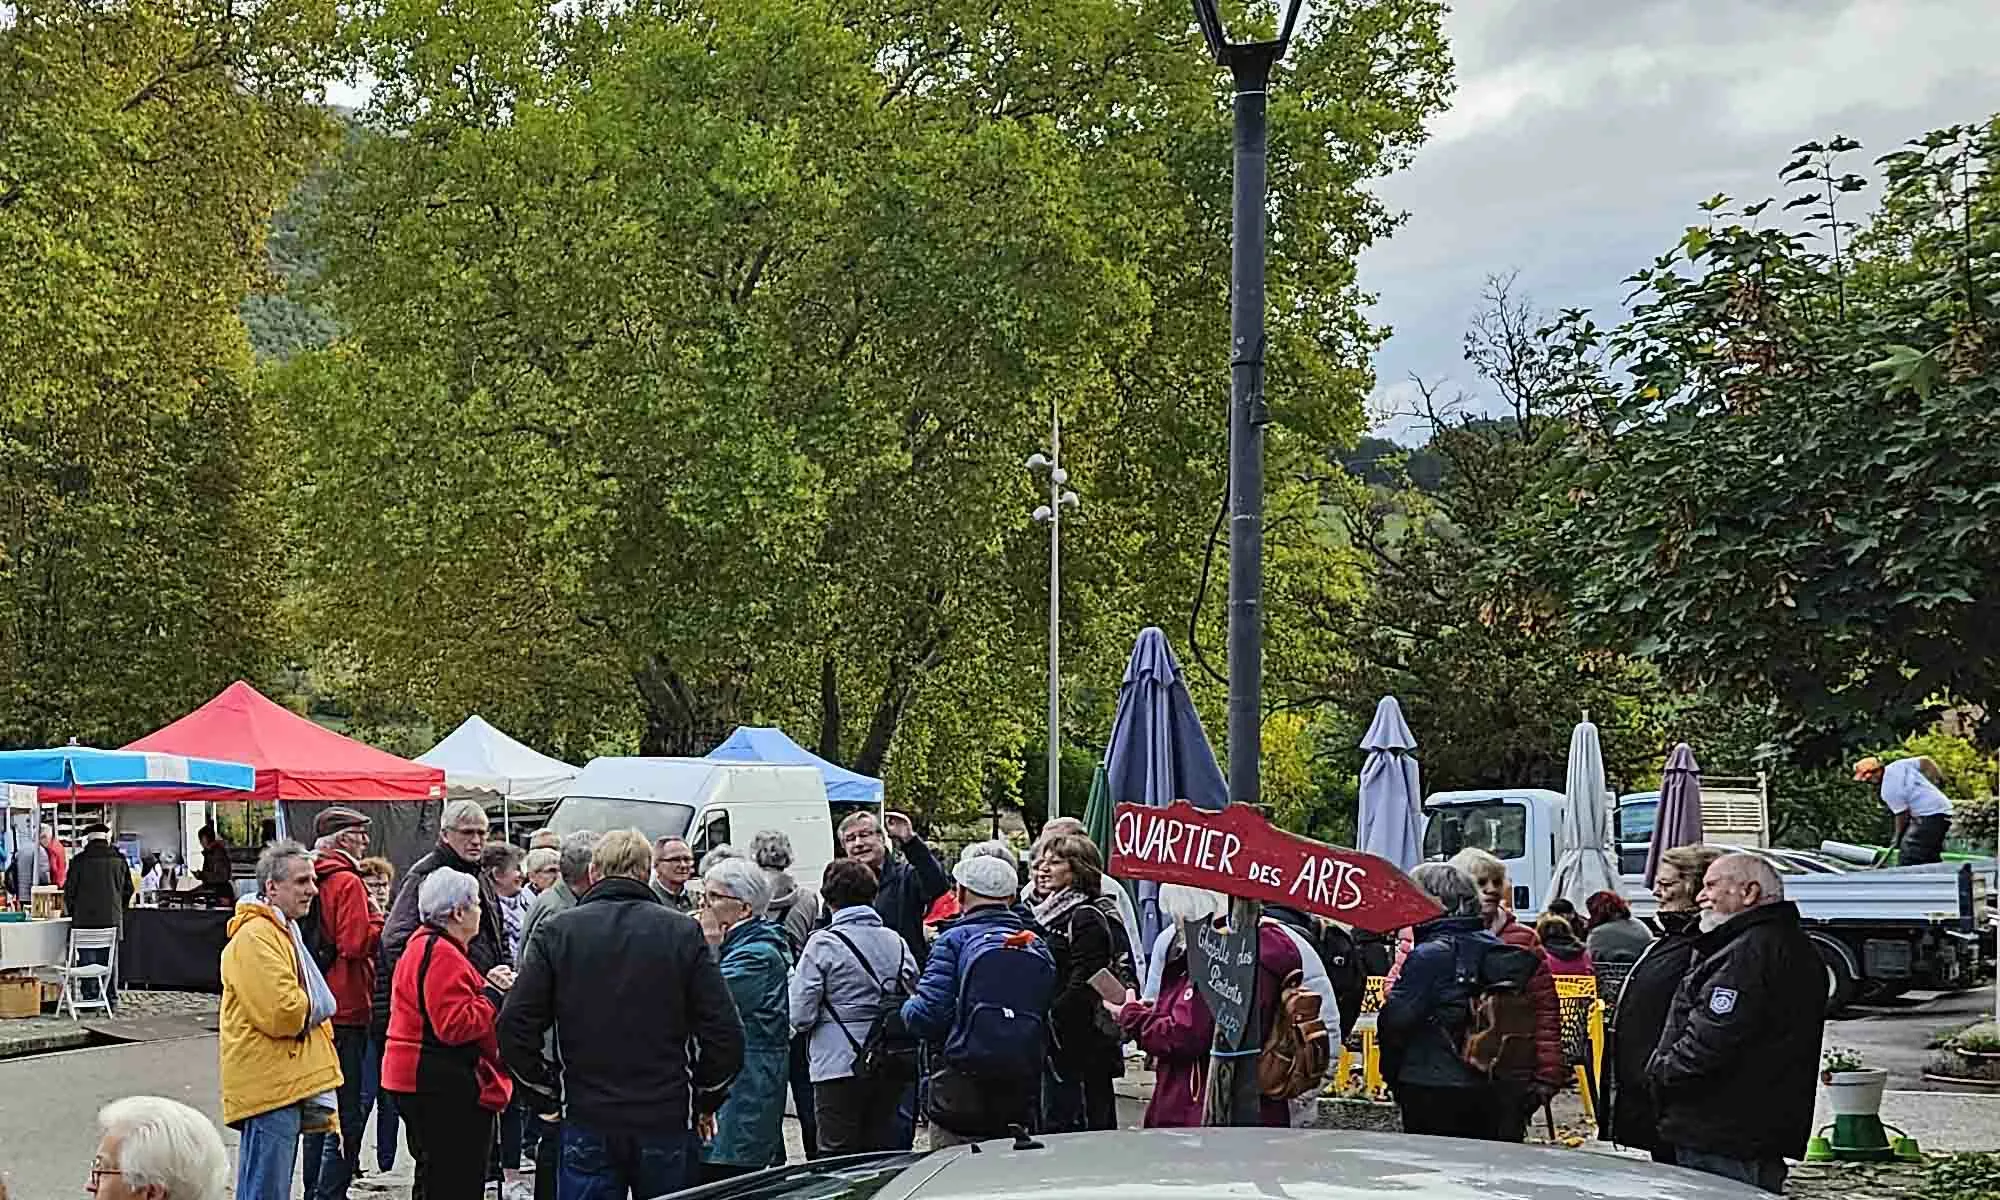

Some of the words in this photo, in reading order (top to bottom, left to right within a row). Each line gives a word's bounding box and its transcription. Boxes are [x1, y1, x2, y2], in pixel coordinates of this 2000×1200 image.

[1115, 811, 1241, 875] QUARTIER
[1248, 861, 1282, 887] DES
[1289, 855, 1367, 910] ARTS
[1236, 937, 1253, 966] des
